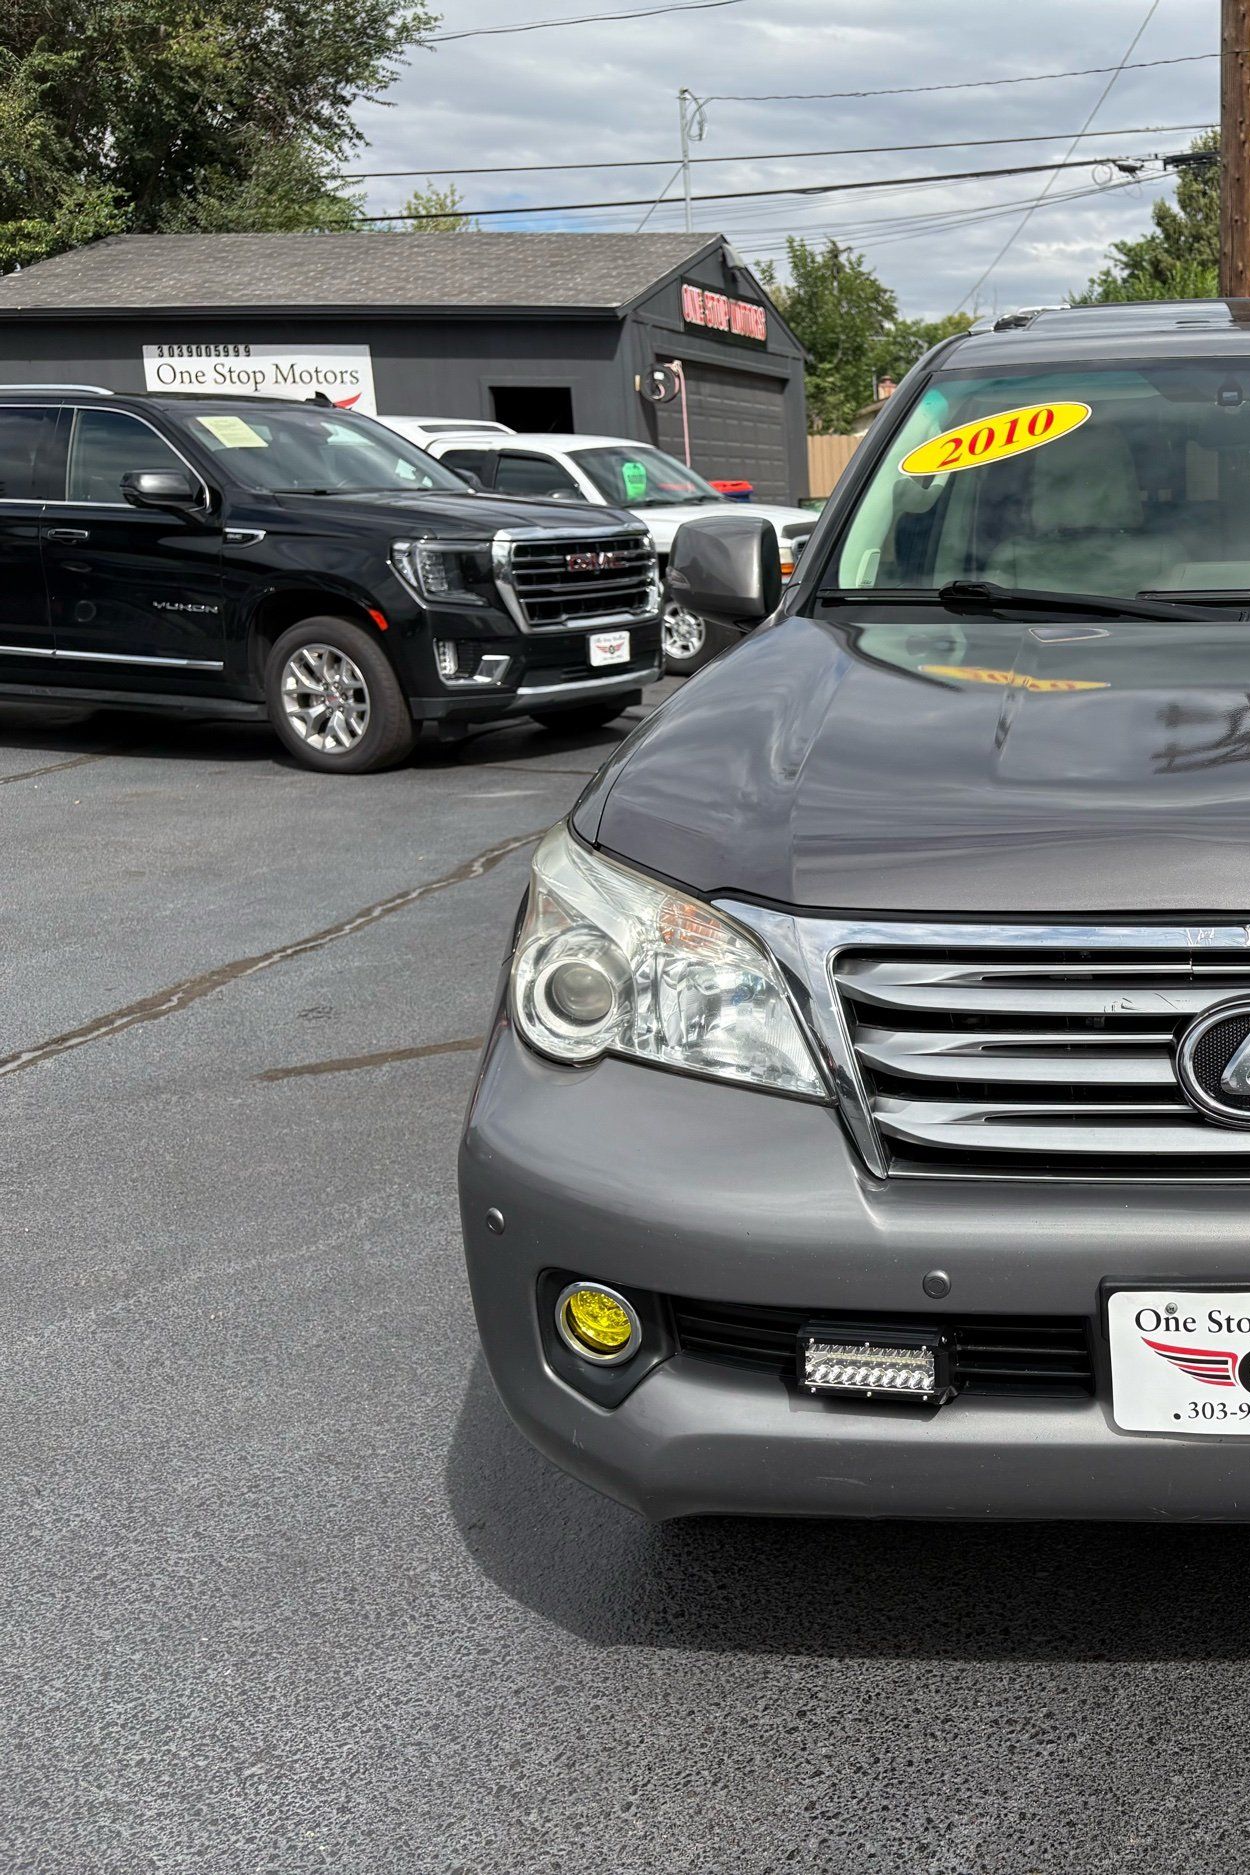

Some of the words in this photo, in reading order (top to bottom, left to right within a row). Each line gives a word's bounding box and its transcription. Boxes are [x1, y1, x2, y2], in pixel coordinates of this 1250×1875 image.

[156, 345, 251, 357] 3039005999
[156, 363, 206, 385] One
[213, 363, 266, 392] Stop
[272, 363, 360, 385] Motors
[937, 408, 1055, 468] 2010
[152, 601, 219, 614] YUKON
[1134, 1308, 1197, 1333] One
